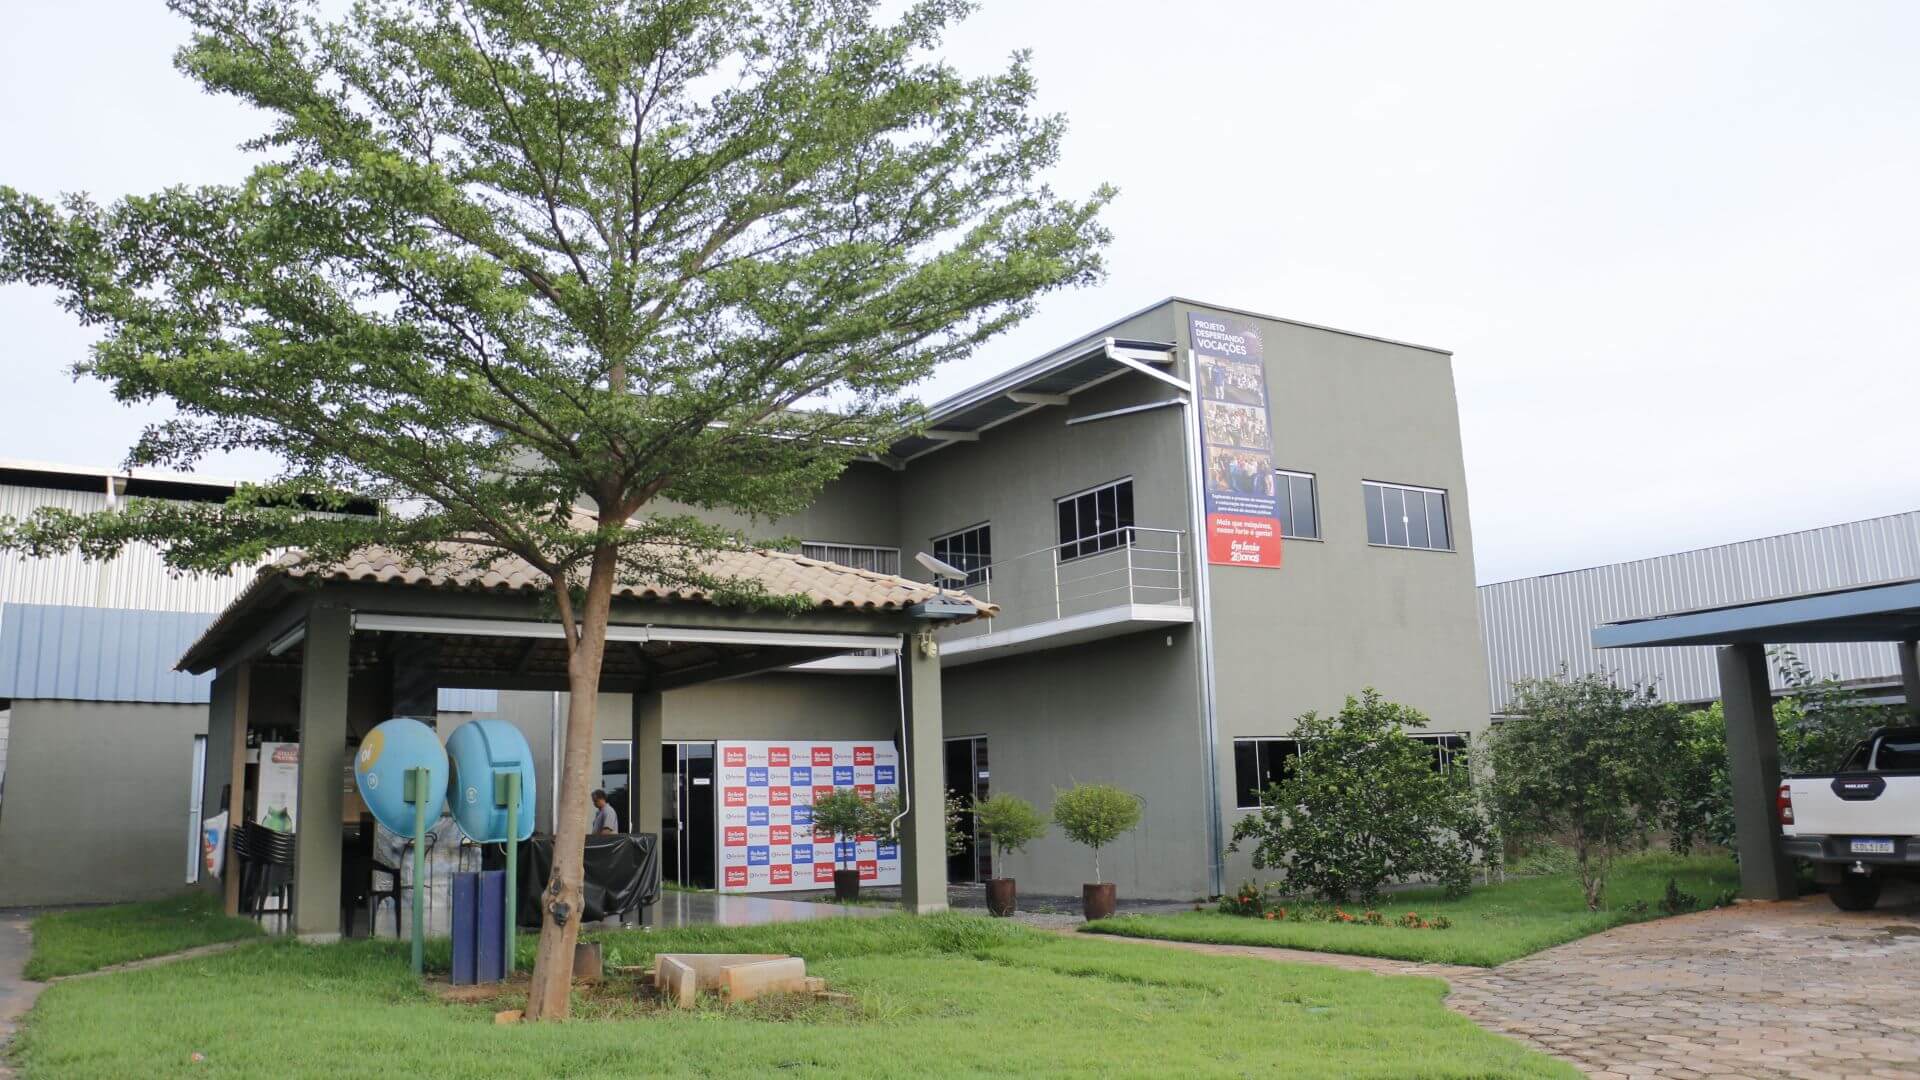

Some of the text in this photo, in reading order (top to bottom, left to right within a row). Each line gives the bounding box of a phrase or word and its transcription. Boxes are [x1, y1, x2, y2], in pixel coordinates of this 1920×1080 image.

[1194, 320, 1225, 332] PROJETO
[1195, 328, 1245, 344] DESPERTANDO
[1197, 337, 1247, 356] VOCAÇÕES
[1216, 518, 1231, 526] Mais
[1231, 520, 1243, 529] que
[1234, 526, 1249, 536] forte
